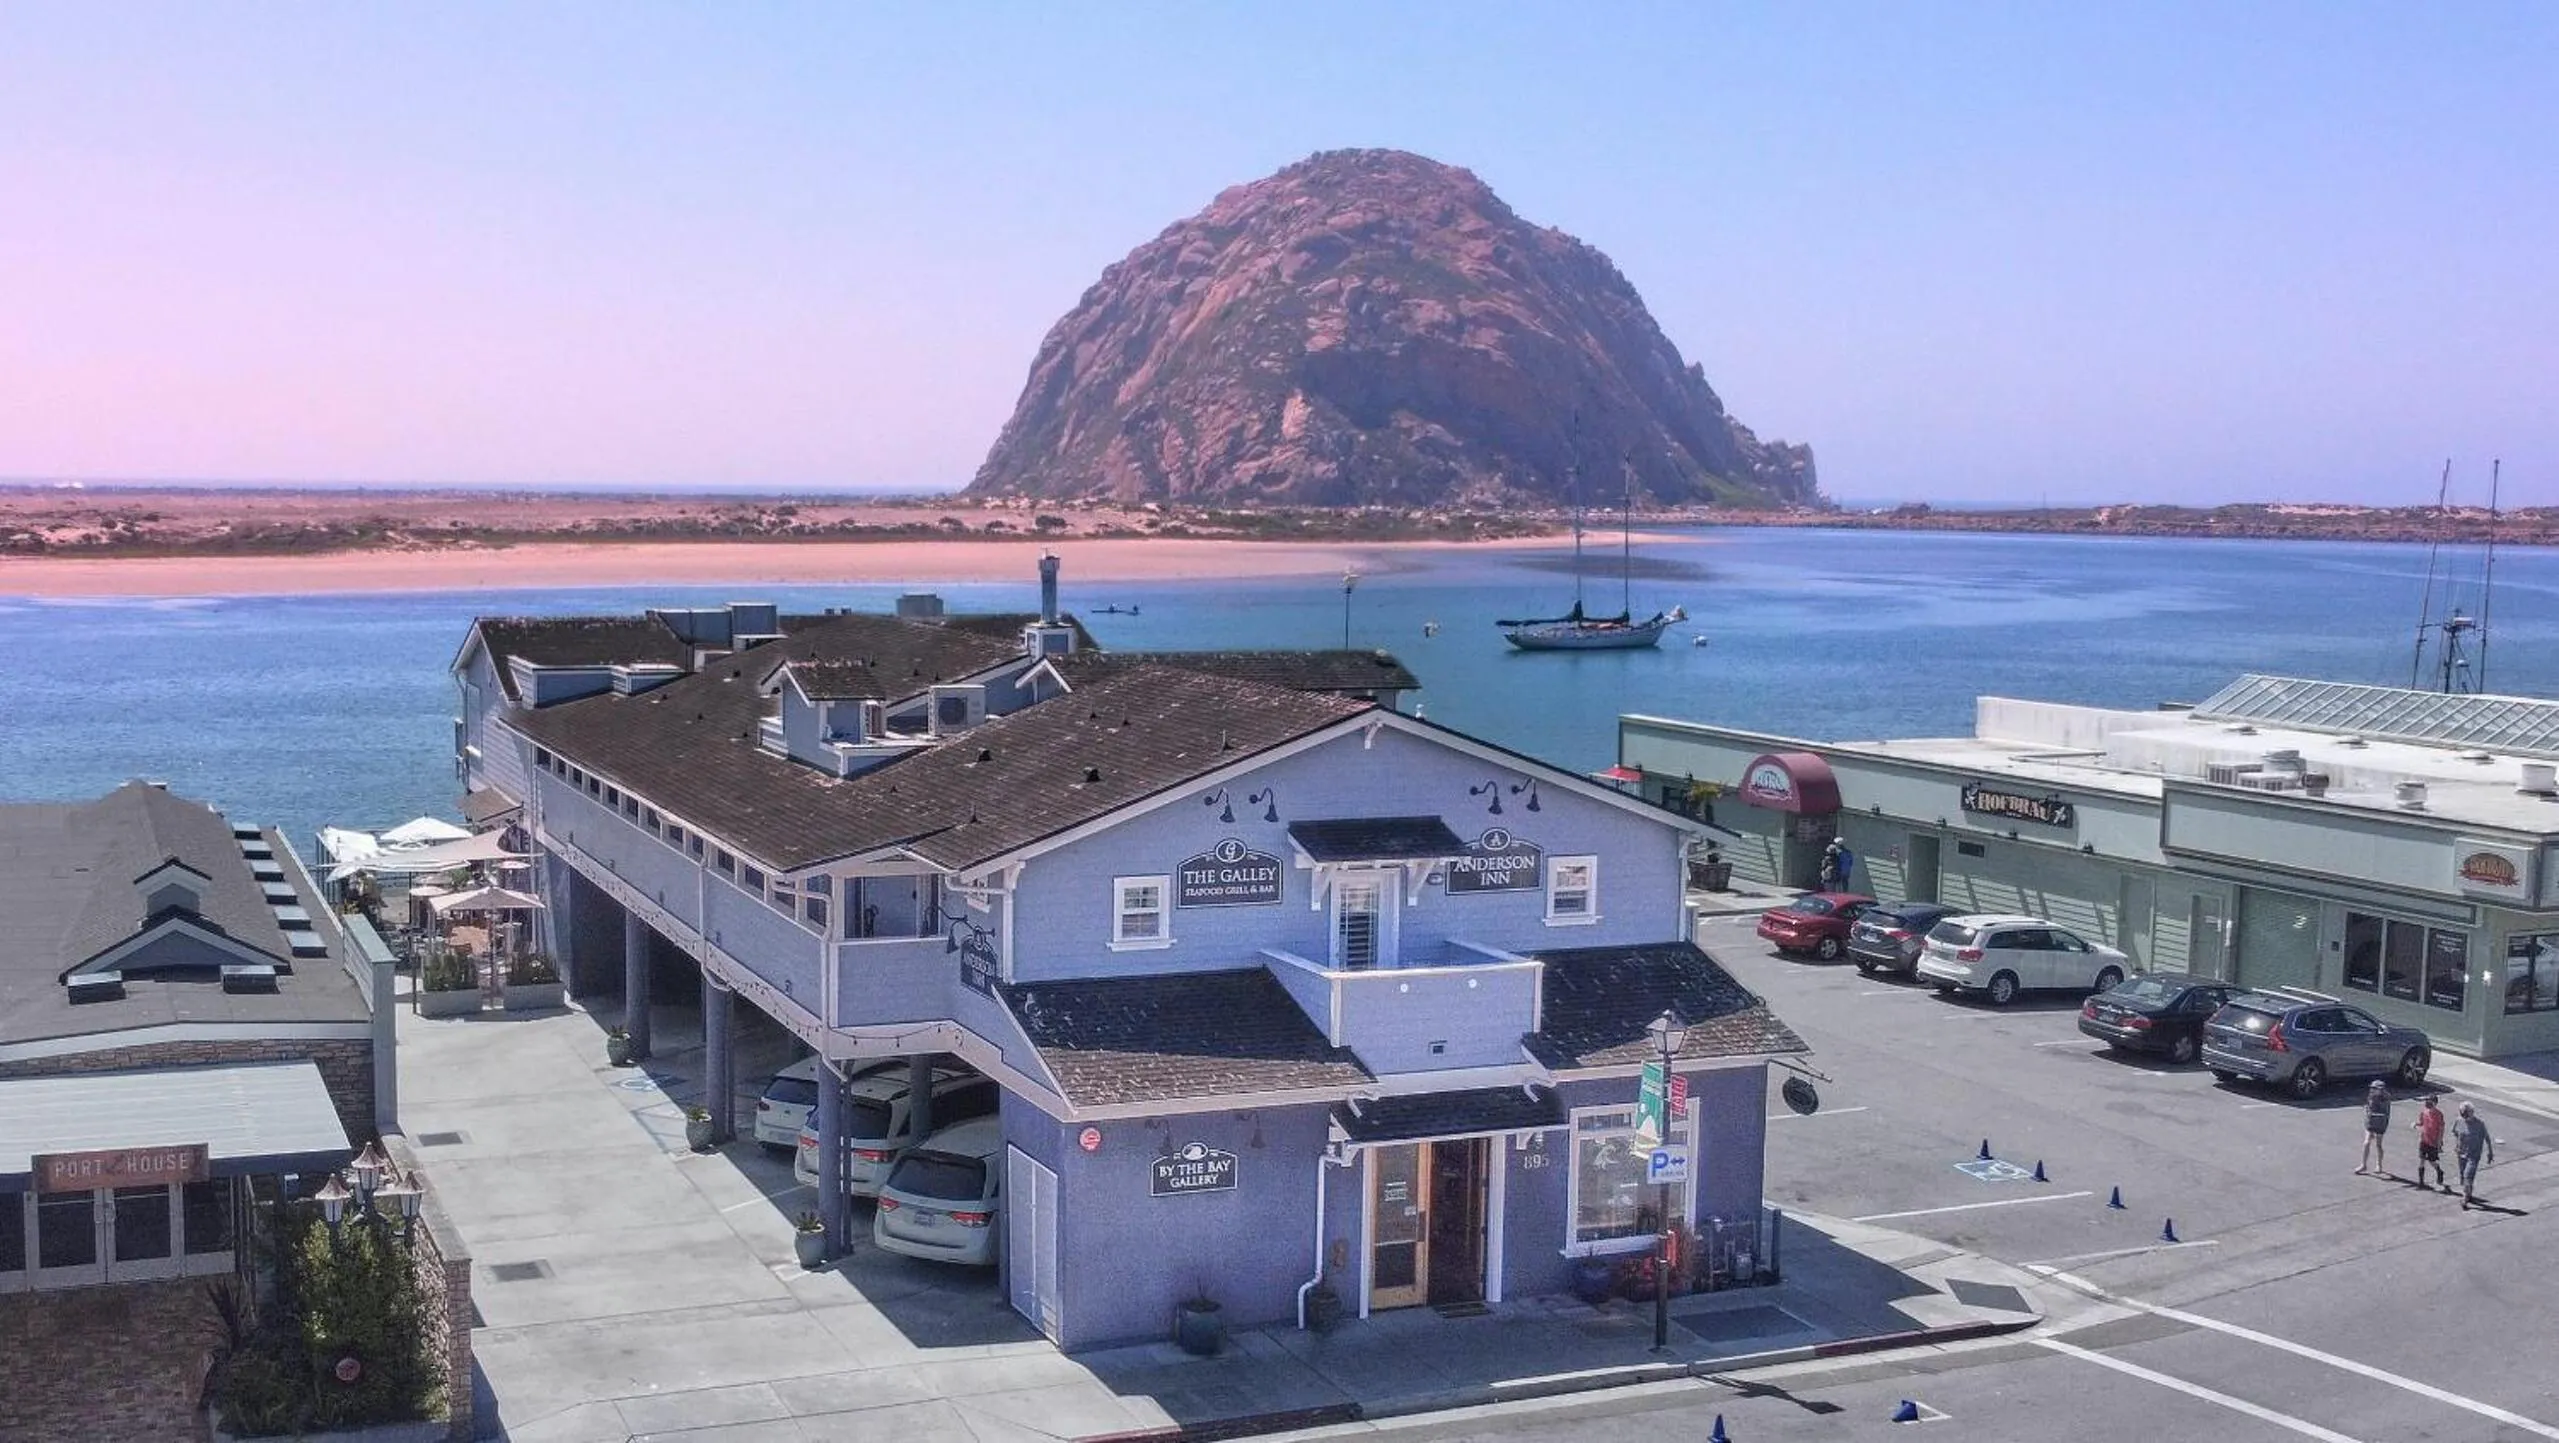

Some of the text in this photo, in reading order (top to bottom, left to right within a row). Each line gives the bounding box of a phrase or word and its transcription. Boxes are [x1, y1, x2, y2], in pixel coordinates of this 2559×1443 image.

[1453, 855, 1536, 872] ANDERSON
[1184, 867, 1277, 885] THE GALLEY
[1480, 871, 1511, 886] INN
[1259, 884, 1275, 894] BAR
[55, 1153, 190, 1178] PORT HOUSE
[1160, 1159, 1231, 1178] BY THE BAY
[1523, 1154, 1551, 1170] 895
[1653, 1152, 1669, 1177] P
[1170, 1174, 1219, 1188] GALLERY
